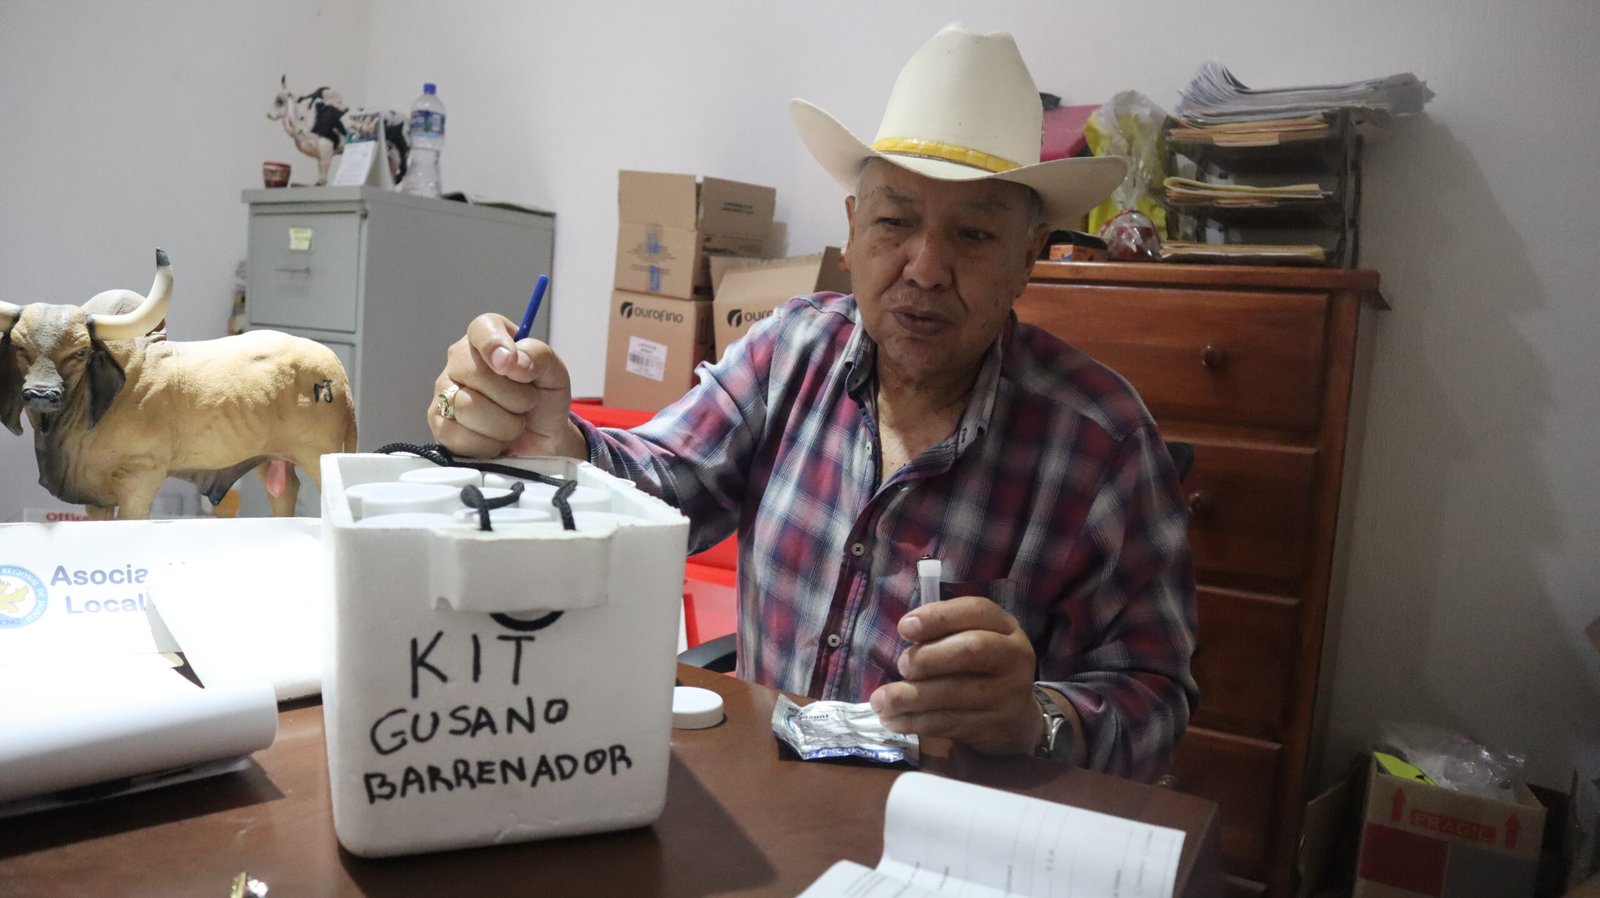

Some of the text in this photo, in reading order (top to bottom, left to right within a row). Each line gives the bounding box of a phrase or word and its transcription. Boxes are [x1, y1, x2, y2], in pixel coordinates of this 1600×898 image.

[634, 307, 684, 324] ourofino
[50, 563, 149, 587] Asocia
[65, 593, 146, 614] Local
[410, 631, 536, 699] KIT
[369, 696, 569, 755] GUSANO
[363, 743, 633, 804] BARRENADOR
